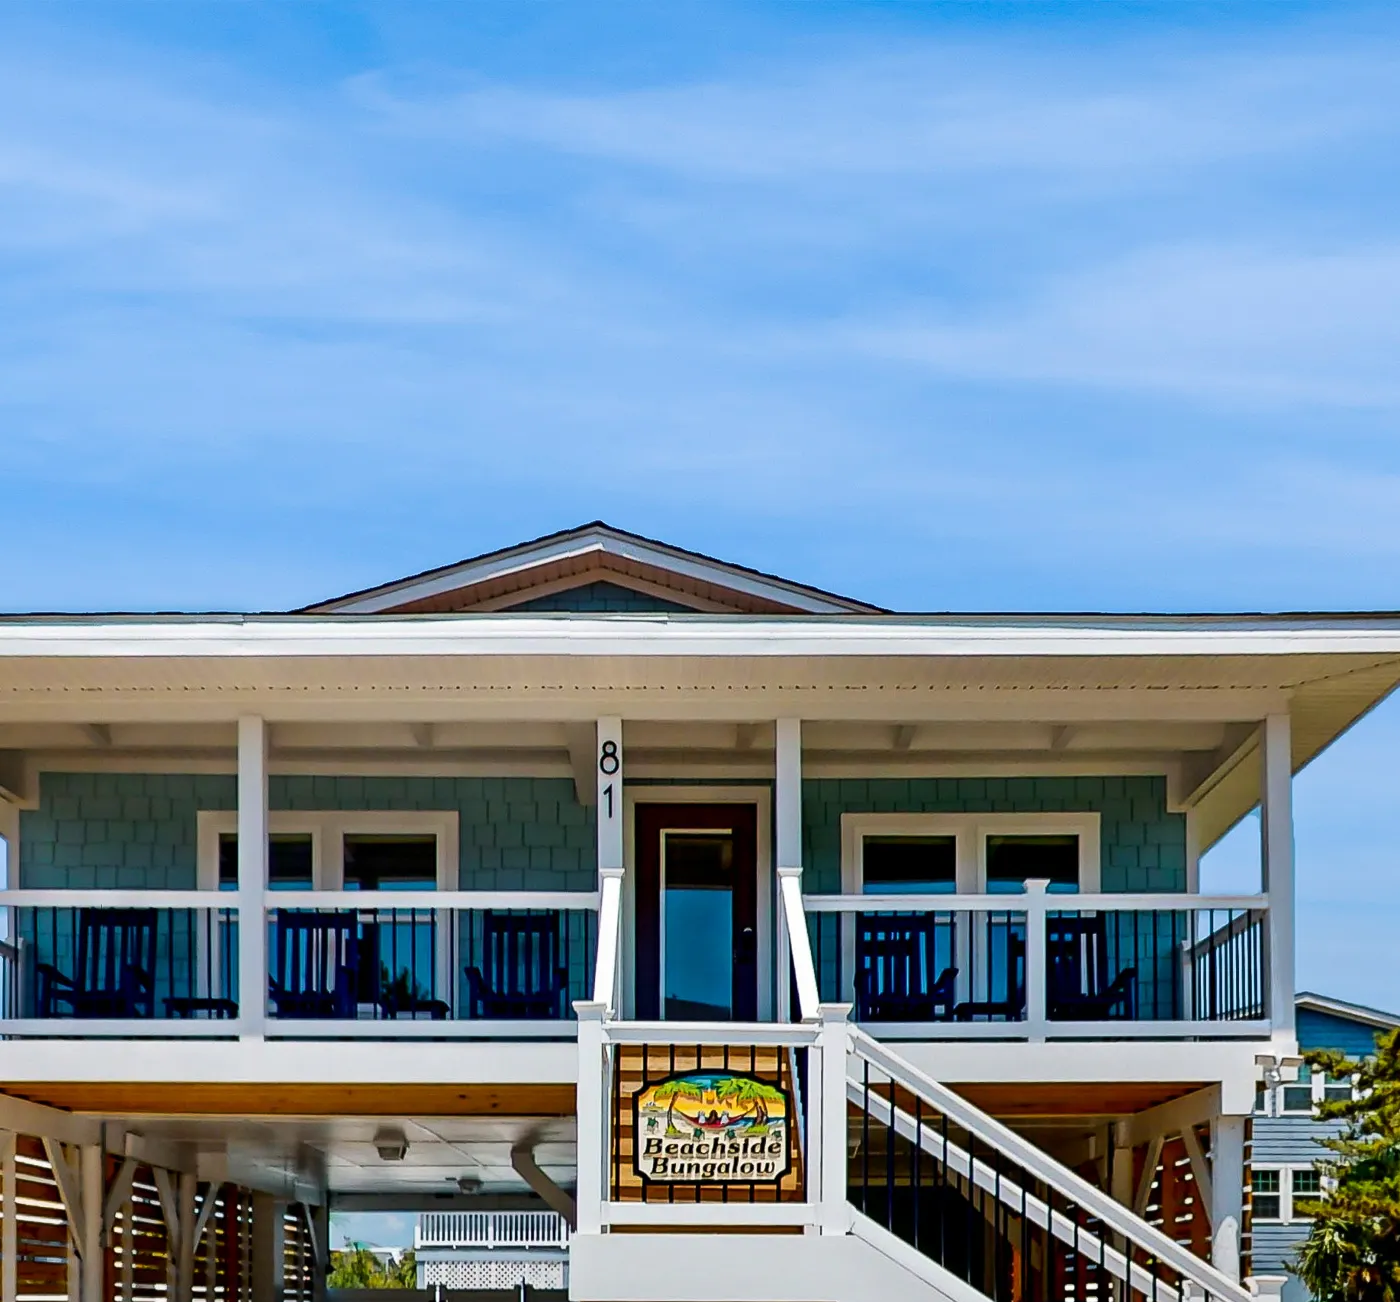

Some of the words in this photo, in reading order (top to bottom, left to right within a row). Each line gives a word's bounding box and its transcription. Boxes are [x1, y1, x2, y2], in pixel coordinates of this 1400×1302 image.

[600, 740, 619, 819] 81
[643, 1137, 782, 1156] Beachside
[650, 1156, 776, 1178] Bungalow
